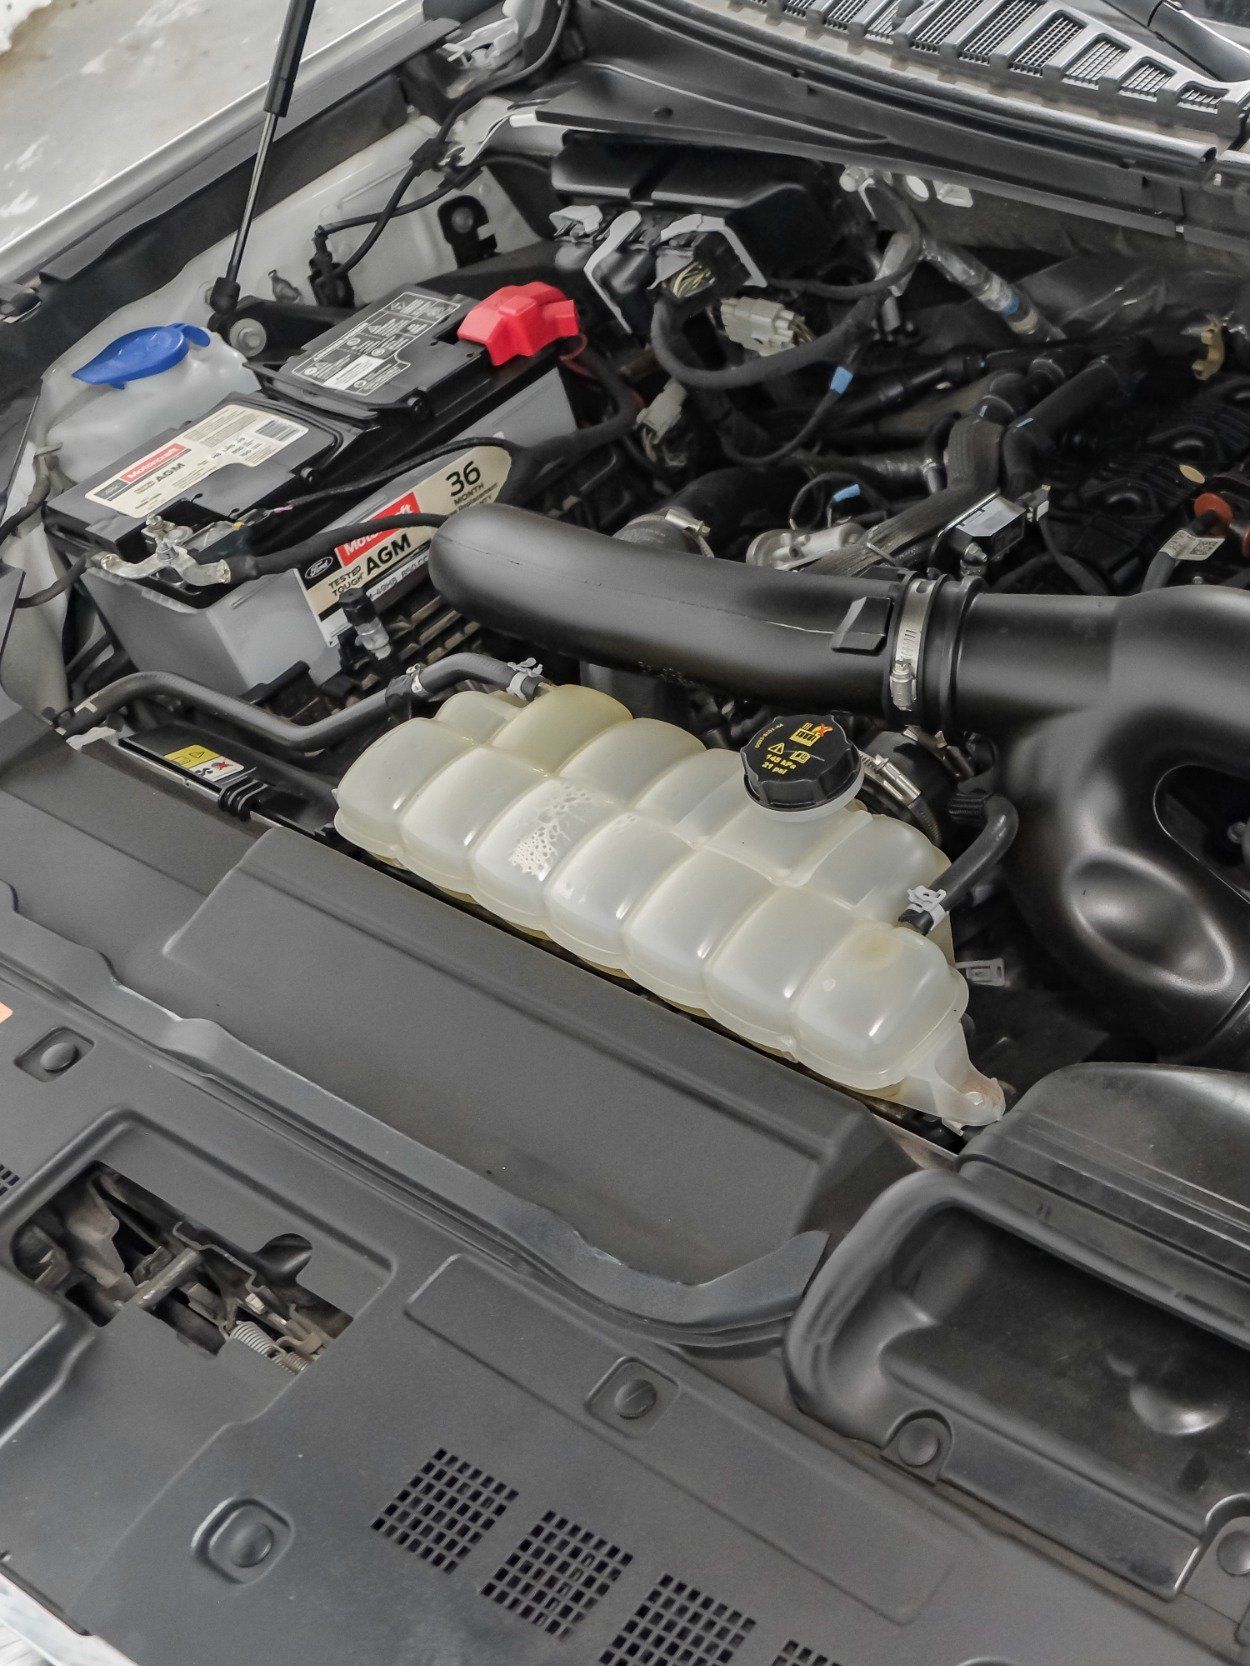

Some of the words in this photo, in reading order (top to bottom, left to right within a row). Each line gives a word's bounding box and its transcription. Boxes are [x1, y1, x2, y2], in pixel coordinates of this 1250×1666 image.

[156, 463, 185, 482] AGM
[445, 461, 481, 497] 36
[454, 482, 484, 506] MONTH
[366, 533, 411, 576] AGM
[328, 565, 361, 589] TESTED
